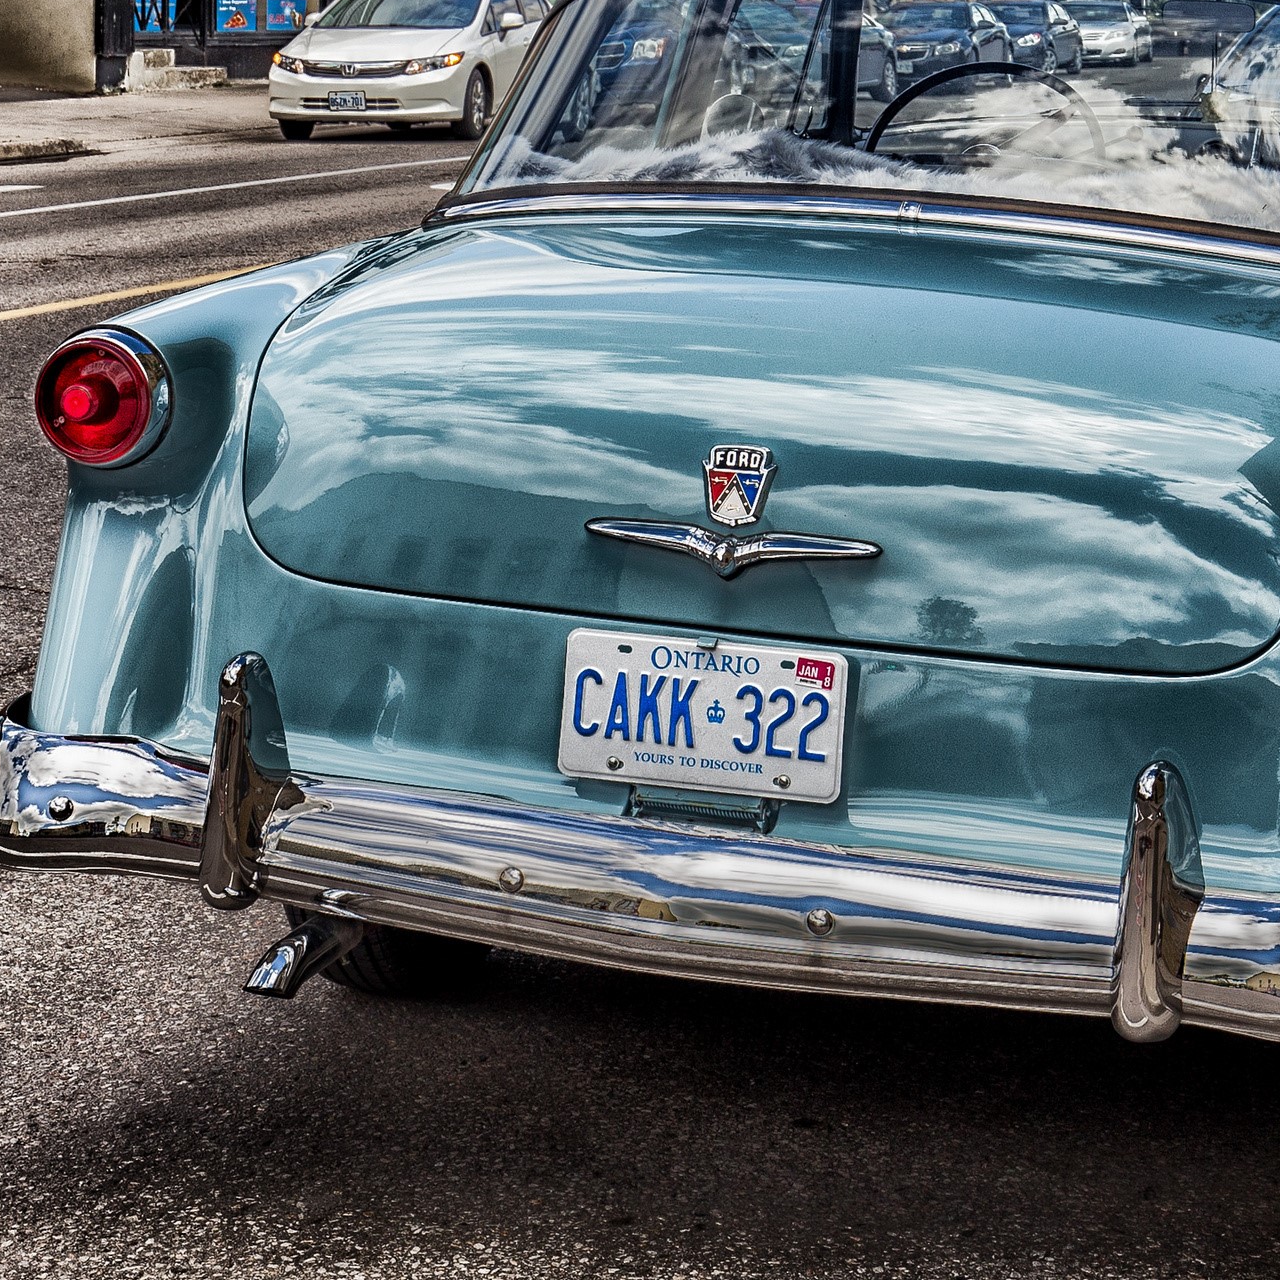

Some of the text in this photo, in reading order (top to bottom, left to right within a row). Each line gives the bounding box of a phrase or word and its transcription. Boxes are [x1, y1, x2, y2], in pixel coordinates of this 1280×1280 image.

[716, 451, 761, 468] FORD
[651, 646, 760, 677] ONTARIO
[799, 665, 818, 678] JAN
[573, 669, 829, 762] CAKK 322
[634, 751, 763, 774] YOURS TO DISCOVER
